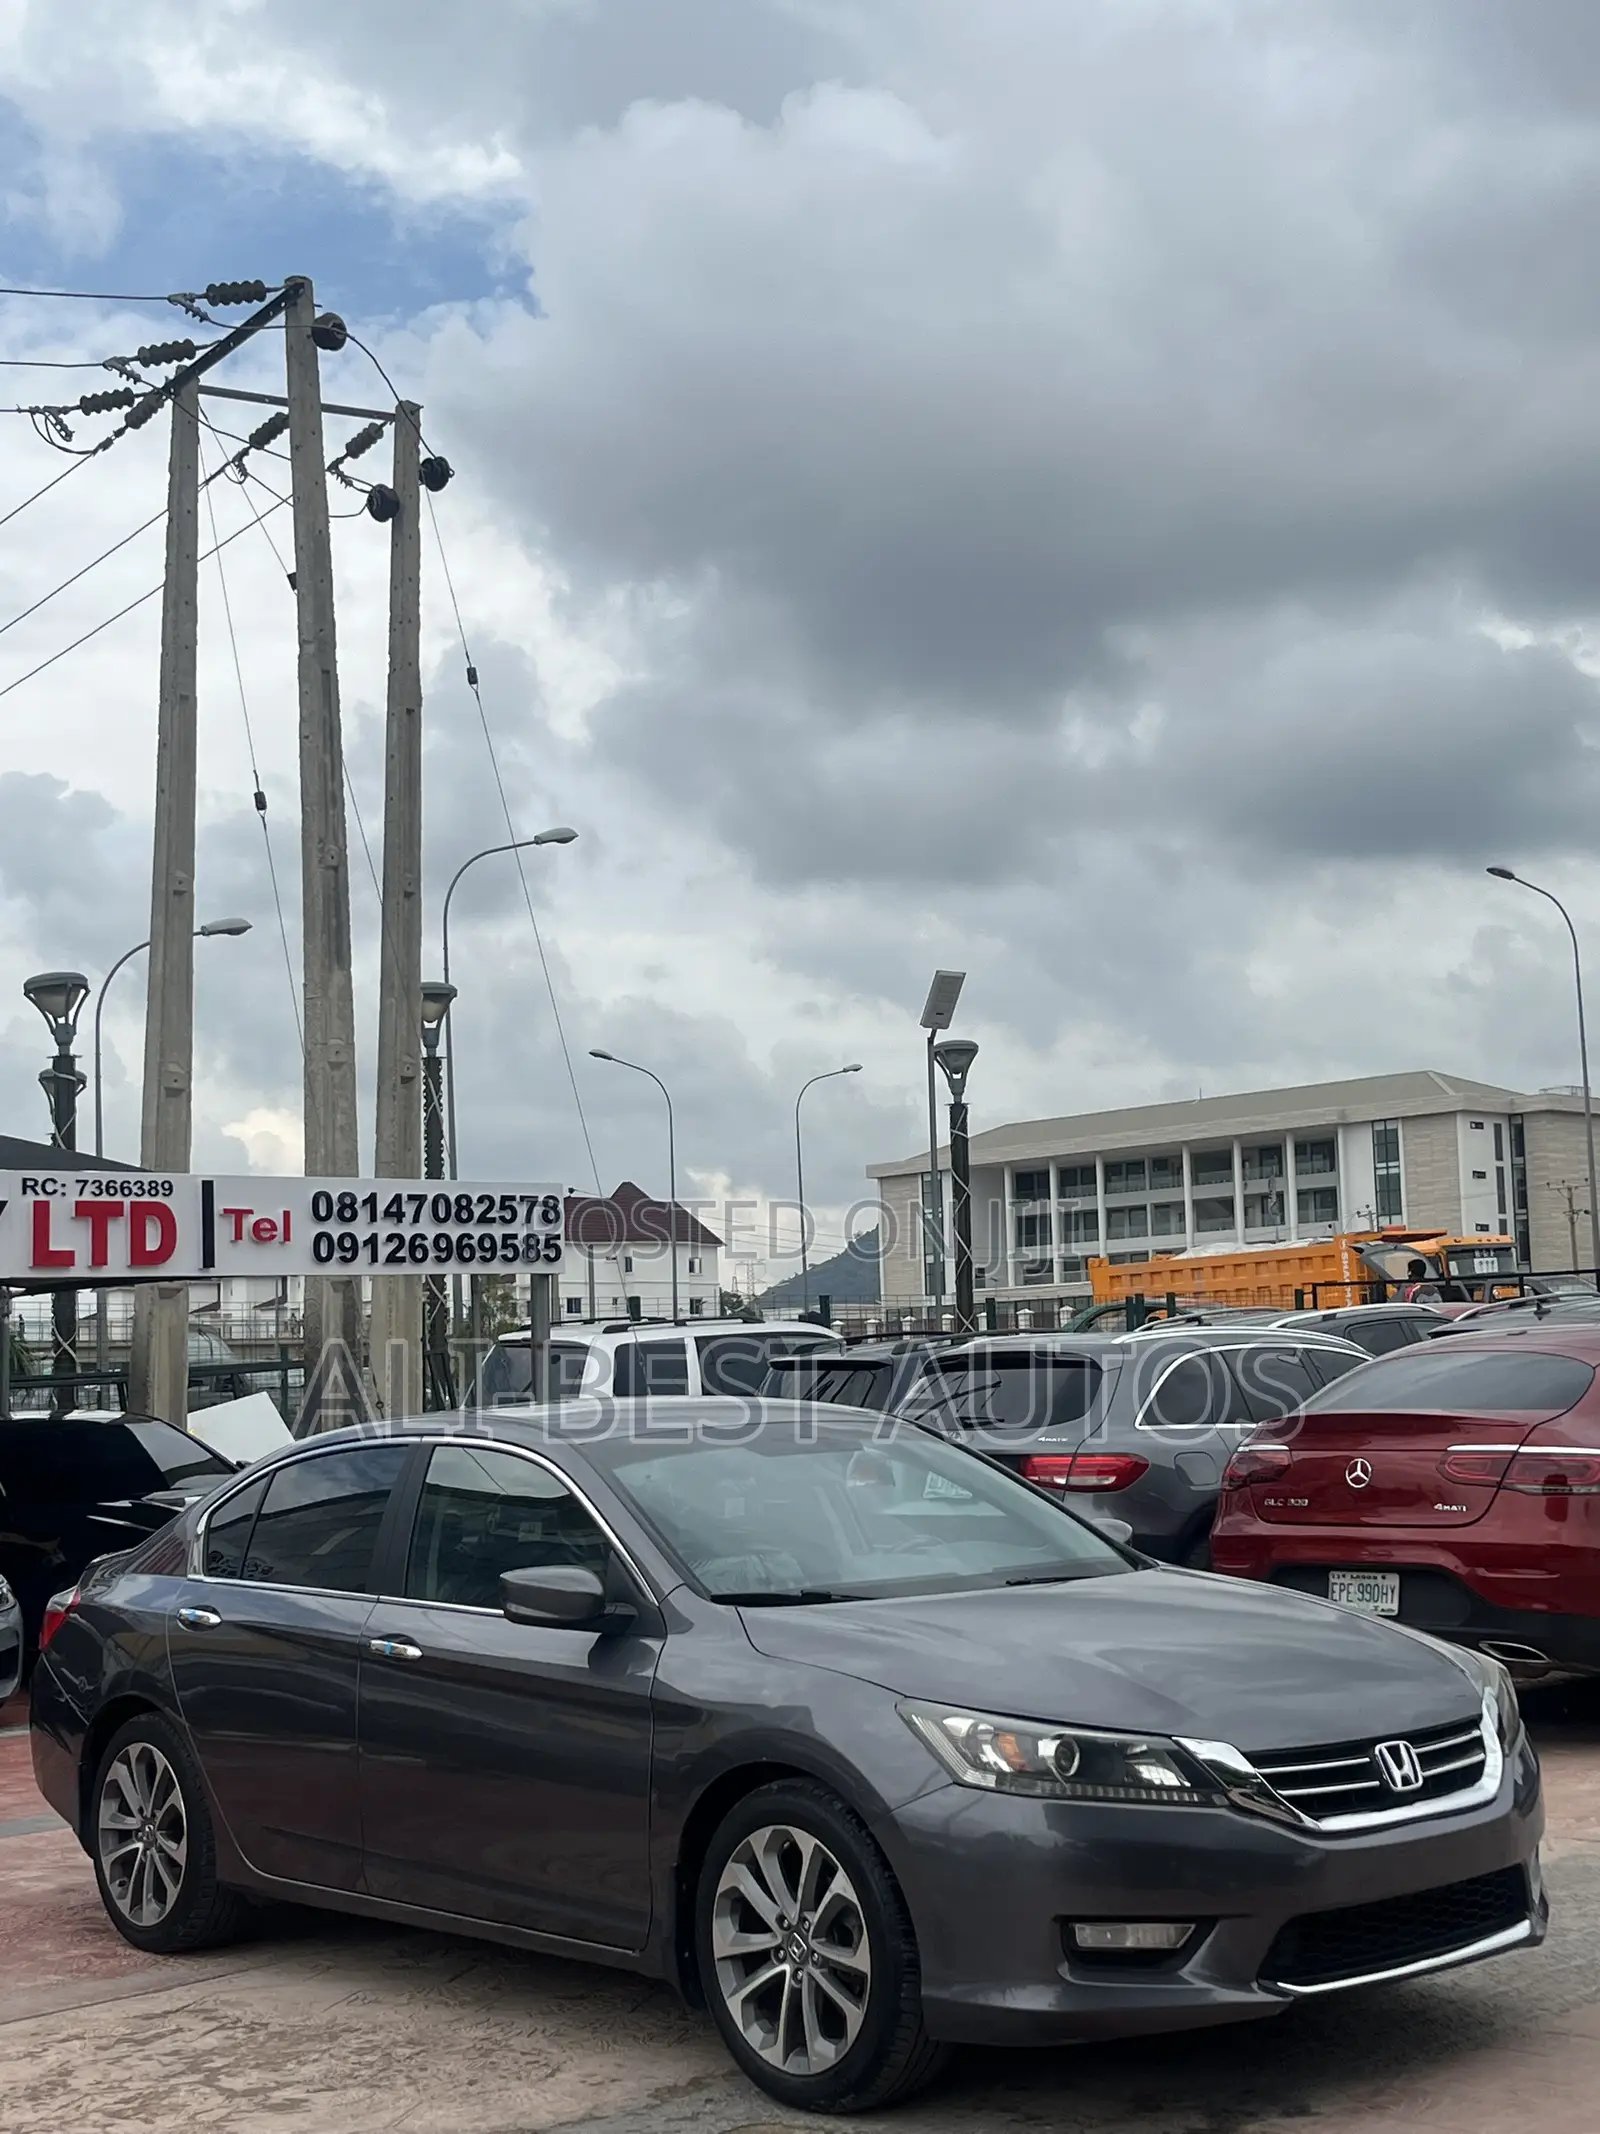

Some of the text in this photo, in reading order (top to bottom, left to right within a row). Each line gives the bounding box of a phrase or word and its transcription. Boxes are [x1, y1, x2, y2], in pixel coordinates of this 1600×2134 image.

[22, 1177, 174, 1197] RC: 7366389
[222, 1207, 291, 1243] Tel
[311, 1190, 562, 1225] 08147082578
[31, 1199, 178, 1267] LTD
[312, 1231, 563, 1264] 09126969585
